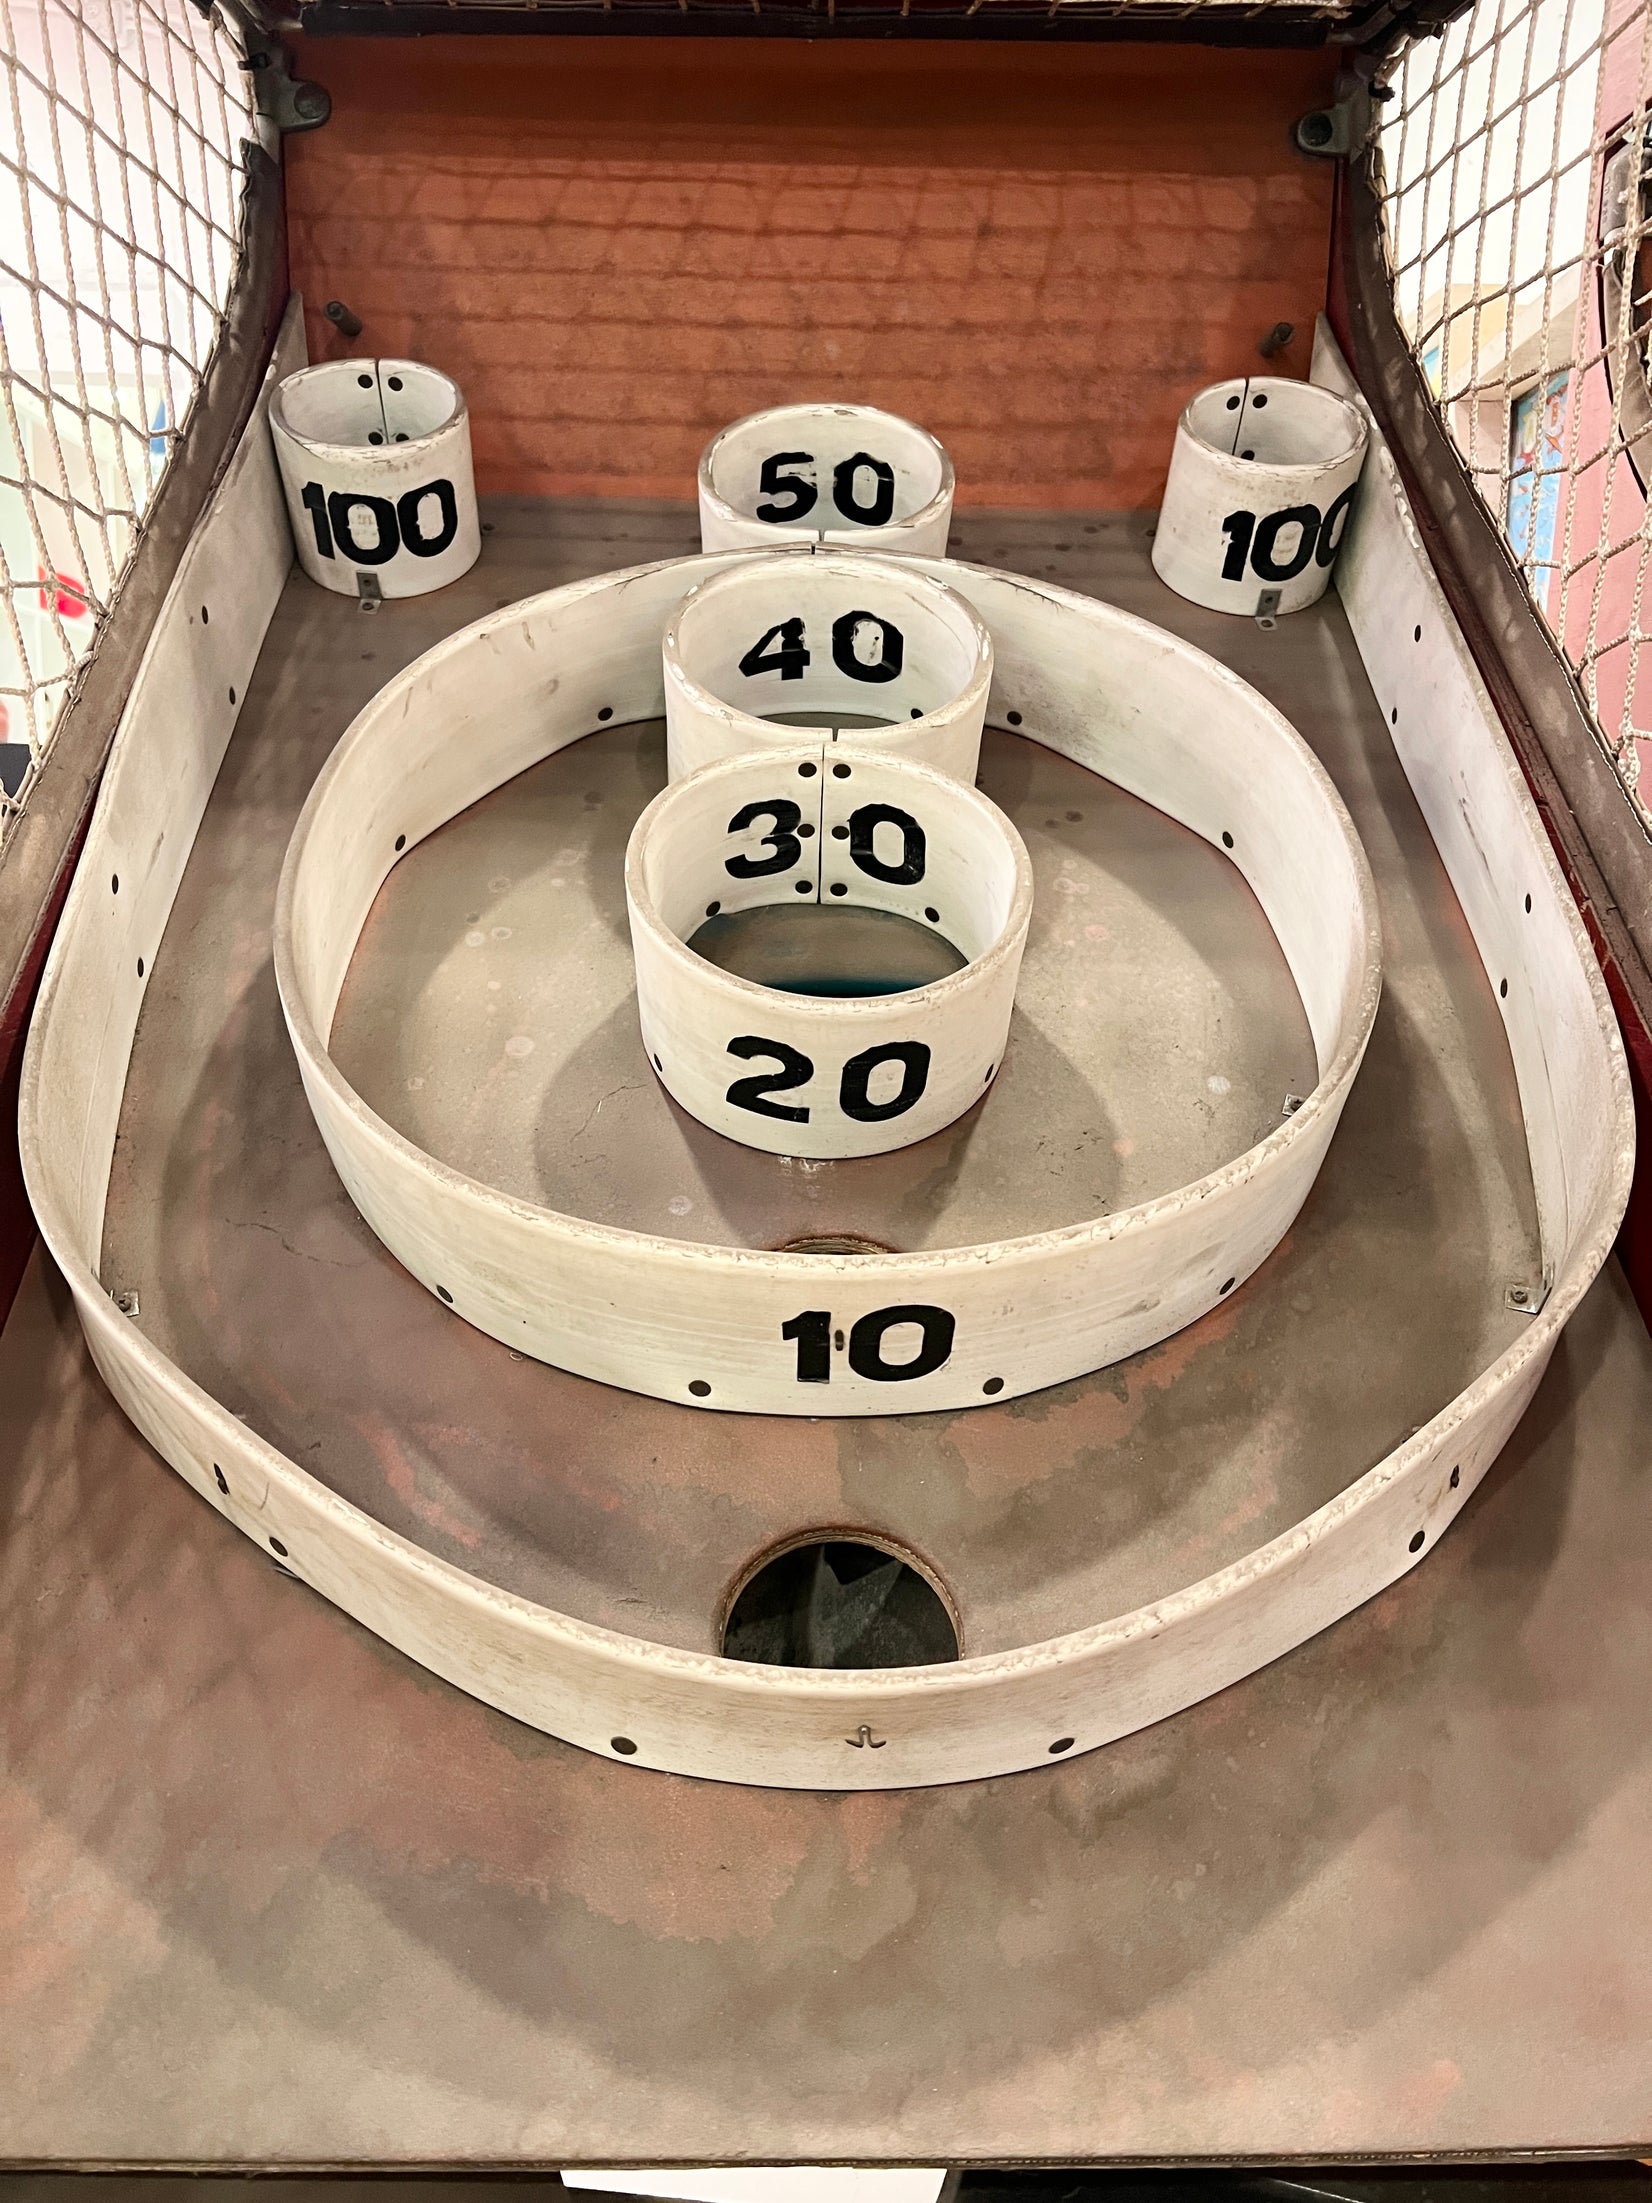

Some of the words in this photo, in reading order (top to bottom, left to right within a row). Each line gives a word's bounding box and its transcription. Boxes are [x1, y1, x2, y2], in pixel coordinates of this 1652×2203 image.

[301, 478, 458, 565] 100
[756, 451, 895, 526] 50
[738, 610, 904, 683] 40
[724, 798, 926, 886] 30
[726, 1035, 931, 1123] 20
[782, 1304, 955, 1384] 10
